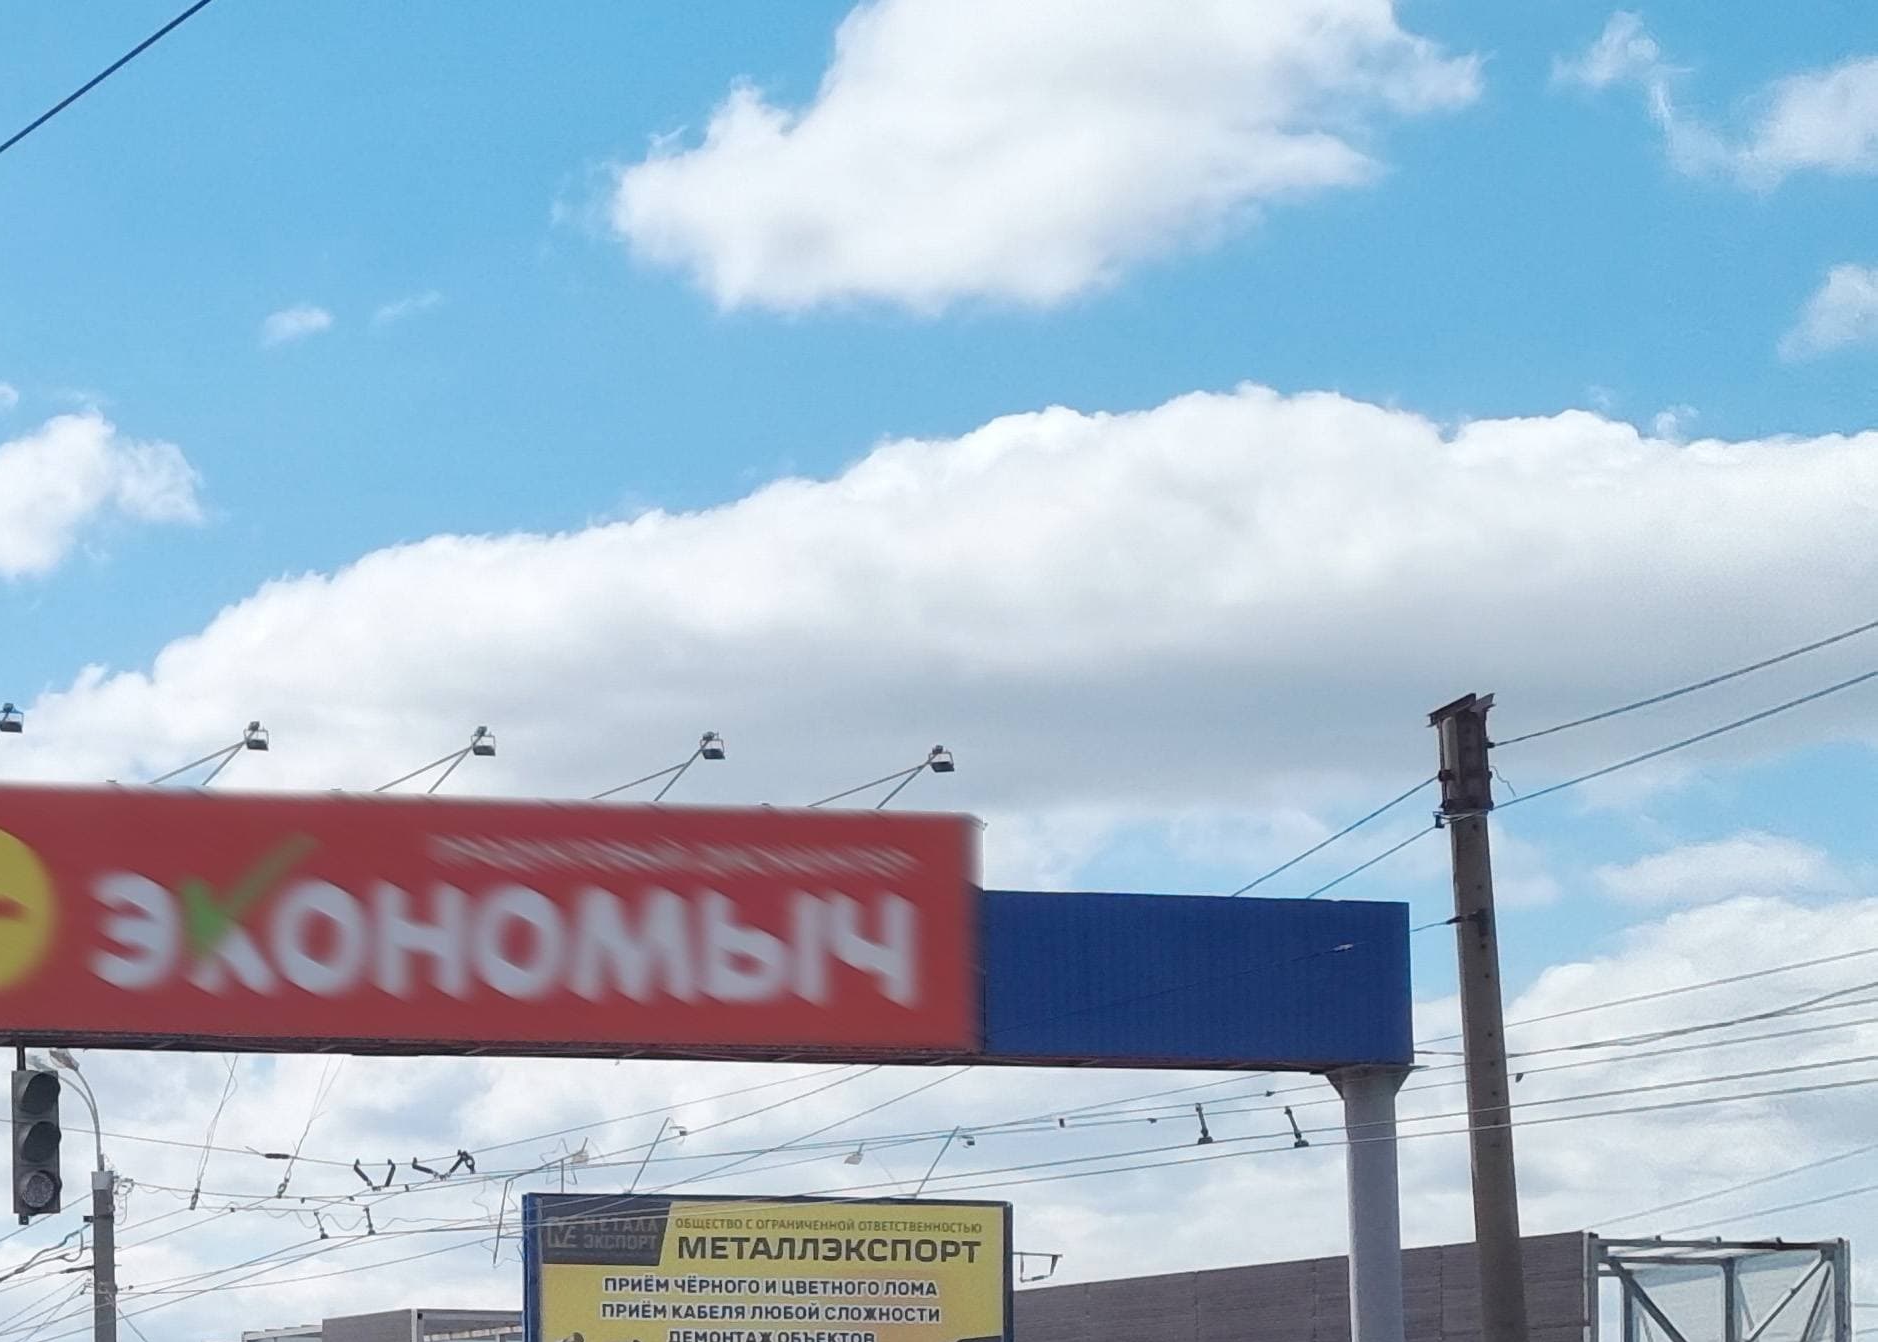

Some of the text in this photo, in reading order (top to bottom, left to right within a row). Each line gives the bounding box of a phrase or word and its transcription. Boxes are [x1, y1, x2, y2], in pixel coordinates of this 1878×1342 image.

[676, 1218, 982, 1234] ОБЩЕСТВО С ОГРАНИЧЕННОЙ ОТВЕТСТВЕННОСТЬЮ
[678, 1236, 981, 1263] МЕТАЛЛЭКСПОРТ
[604, 1275, 938, 1297] ПРИЁМ ЧЁРНОГО И ЦВЕТНОГО ЛОМА
[601, 1301, 940, 1322] ПРИЁМ КАБЕЛЯ ЛЮБОЙ СЛОЖНОСТИ
